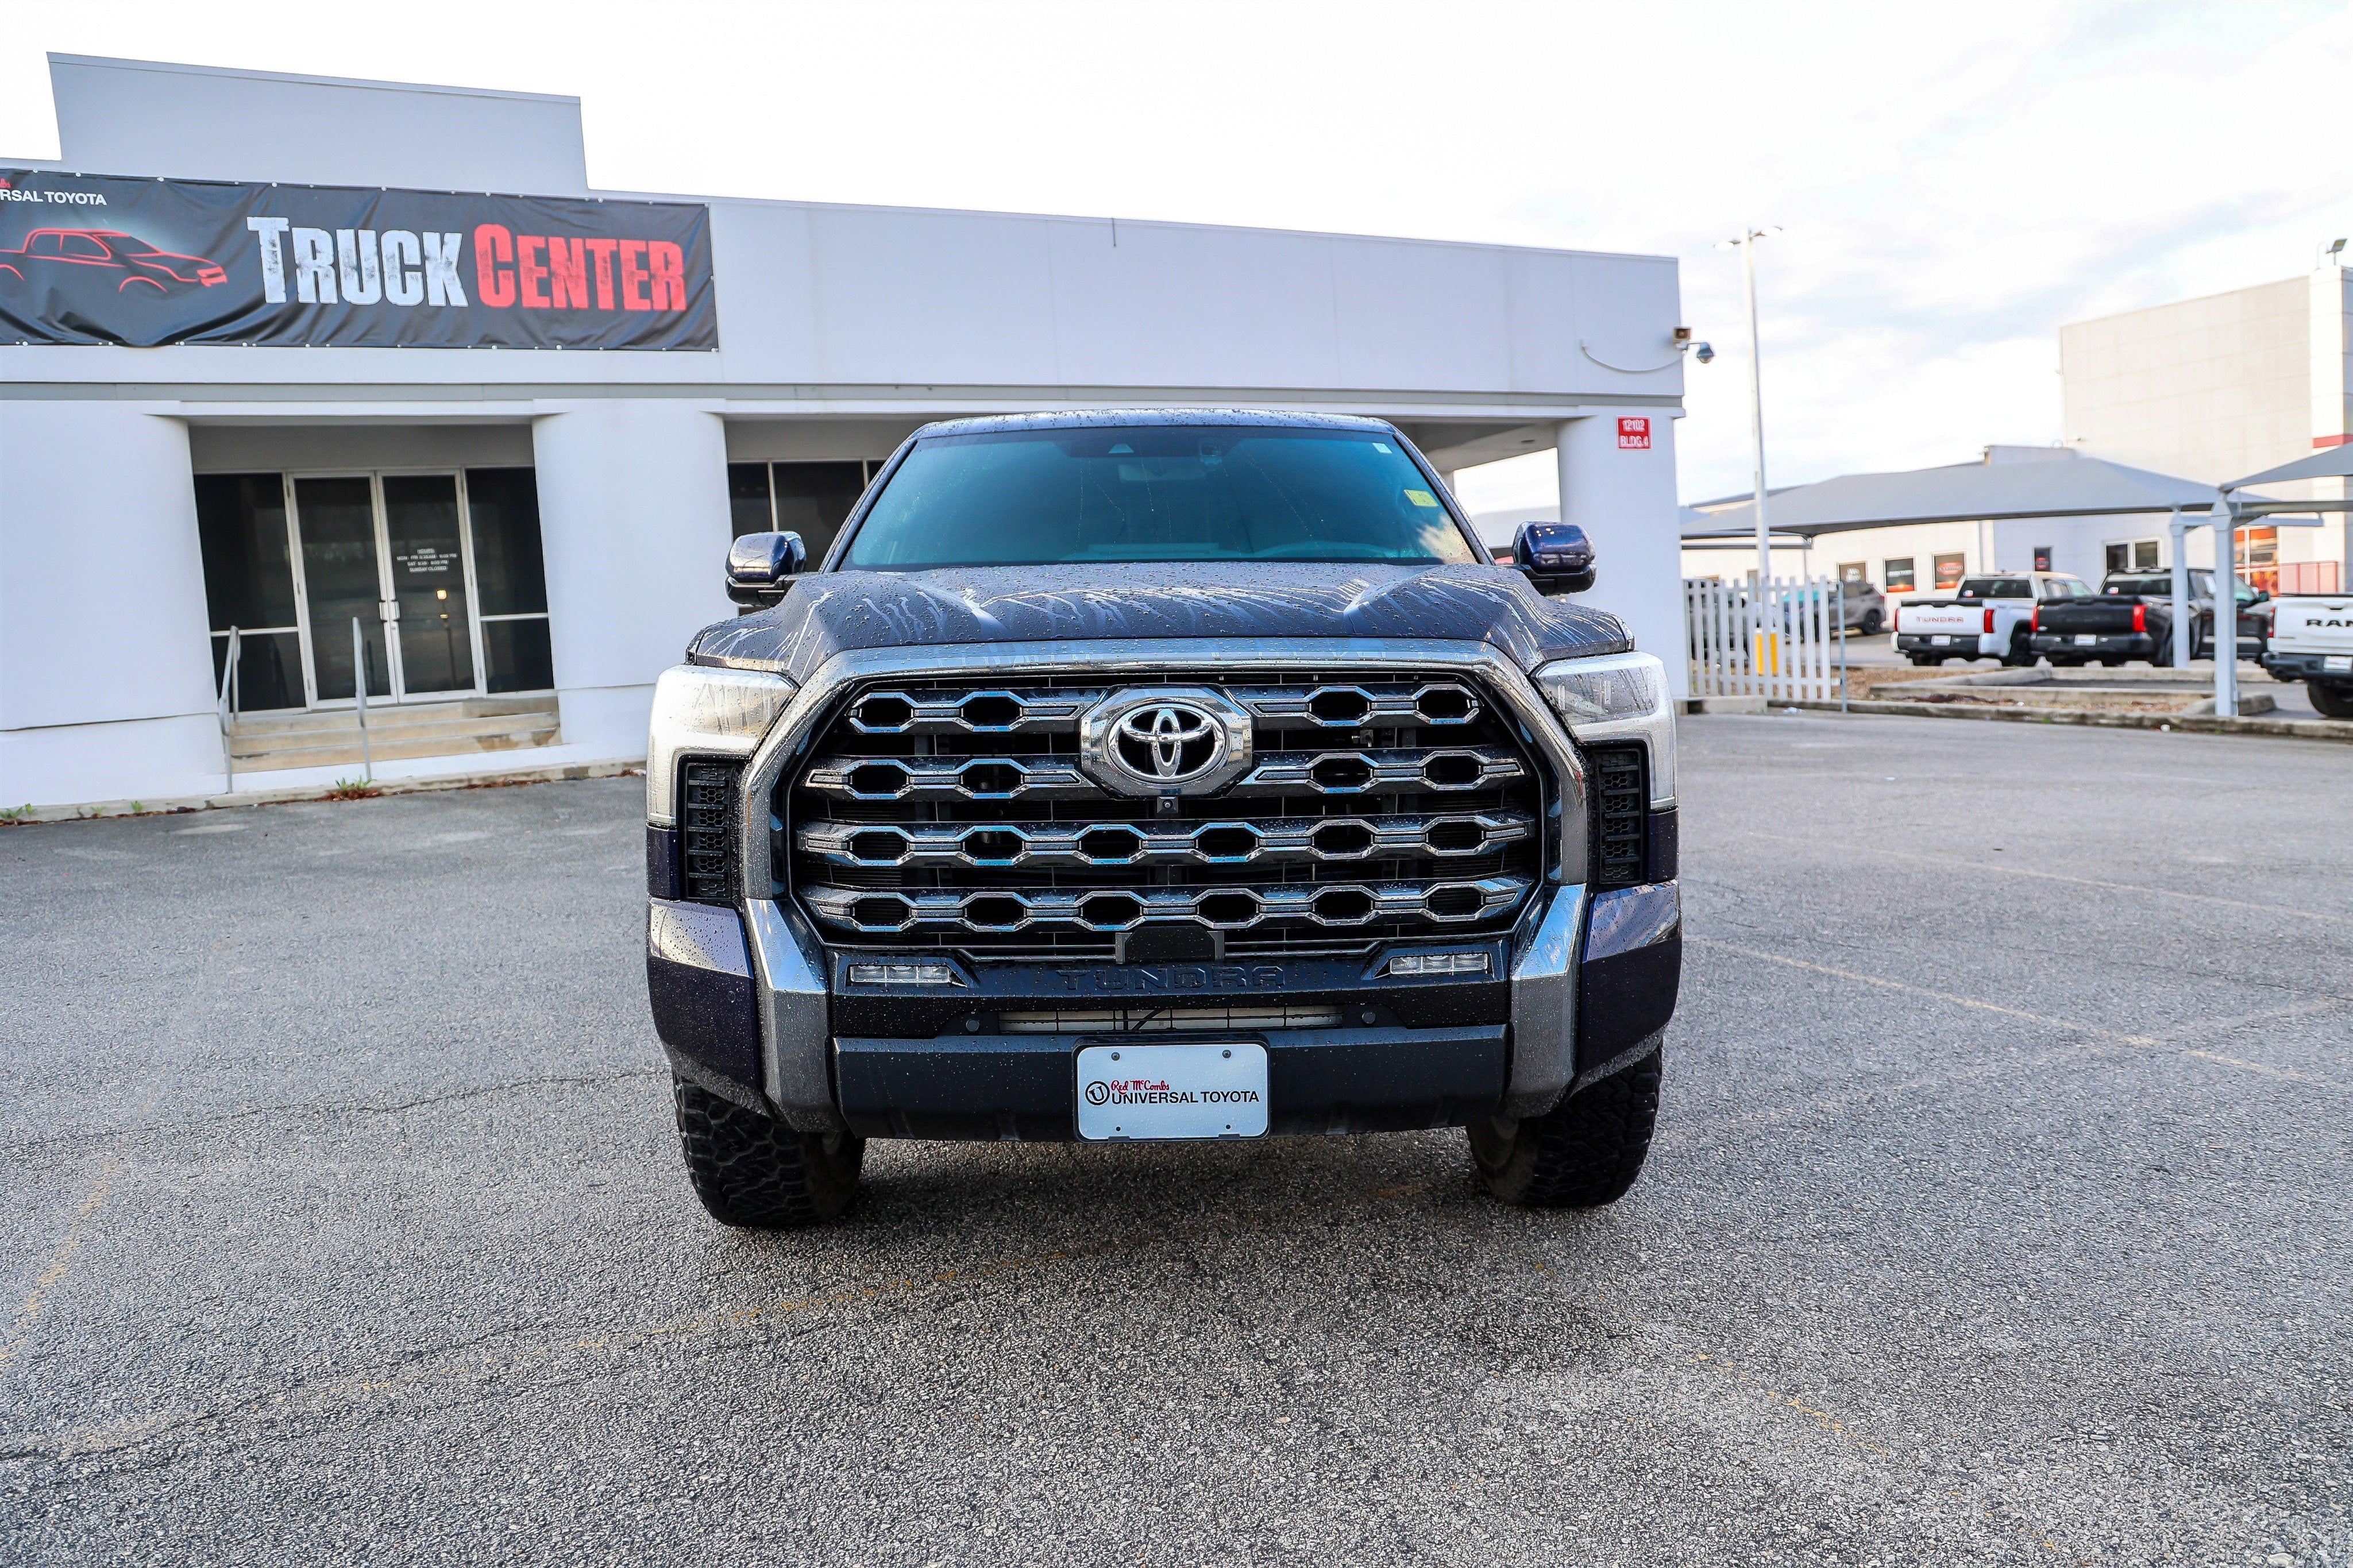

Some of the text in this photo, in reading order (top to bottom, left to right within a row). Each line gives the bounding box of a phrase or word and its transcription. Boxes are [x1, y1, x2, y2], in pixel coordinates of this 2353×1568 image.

[44, 191, 107, 206] TOYOTA
[1056, 966, 1285, 990] TUNDRA
[1111, 1080, 1170, 1095] Red McCombs
[1111, 1090, 1260, 1104] UNIVERSAL TOYOTA
